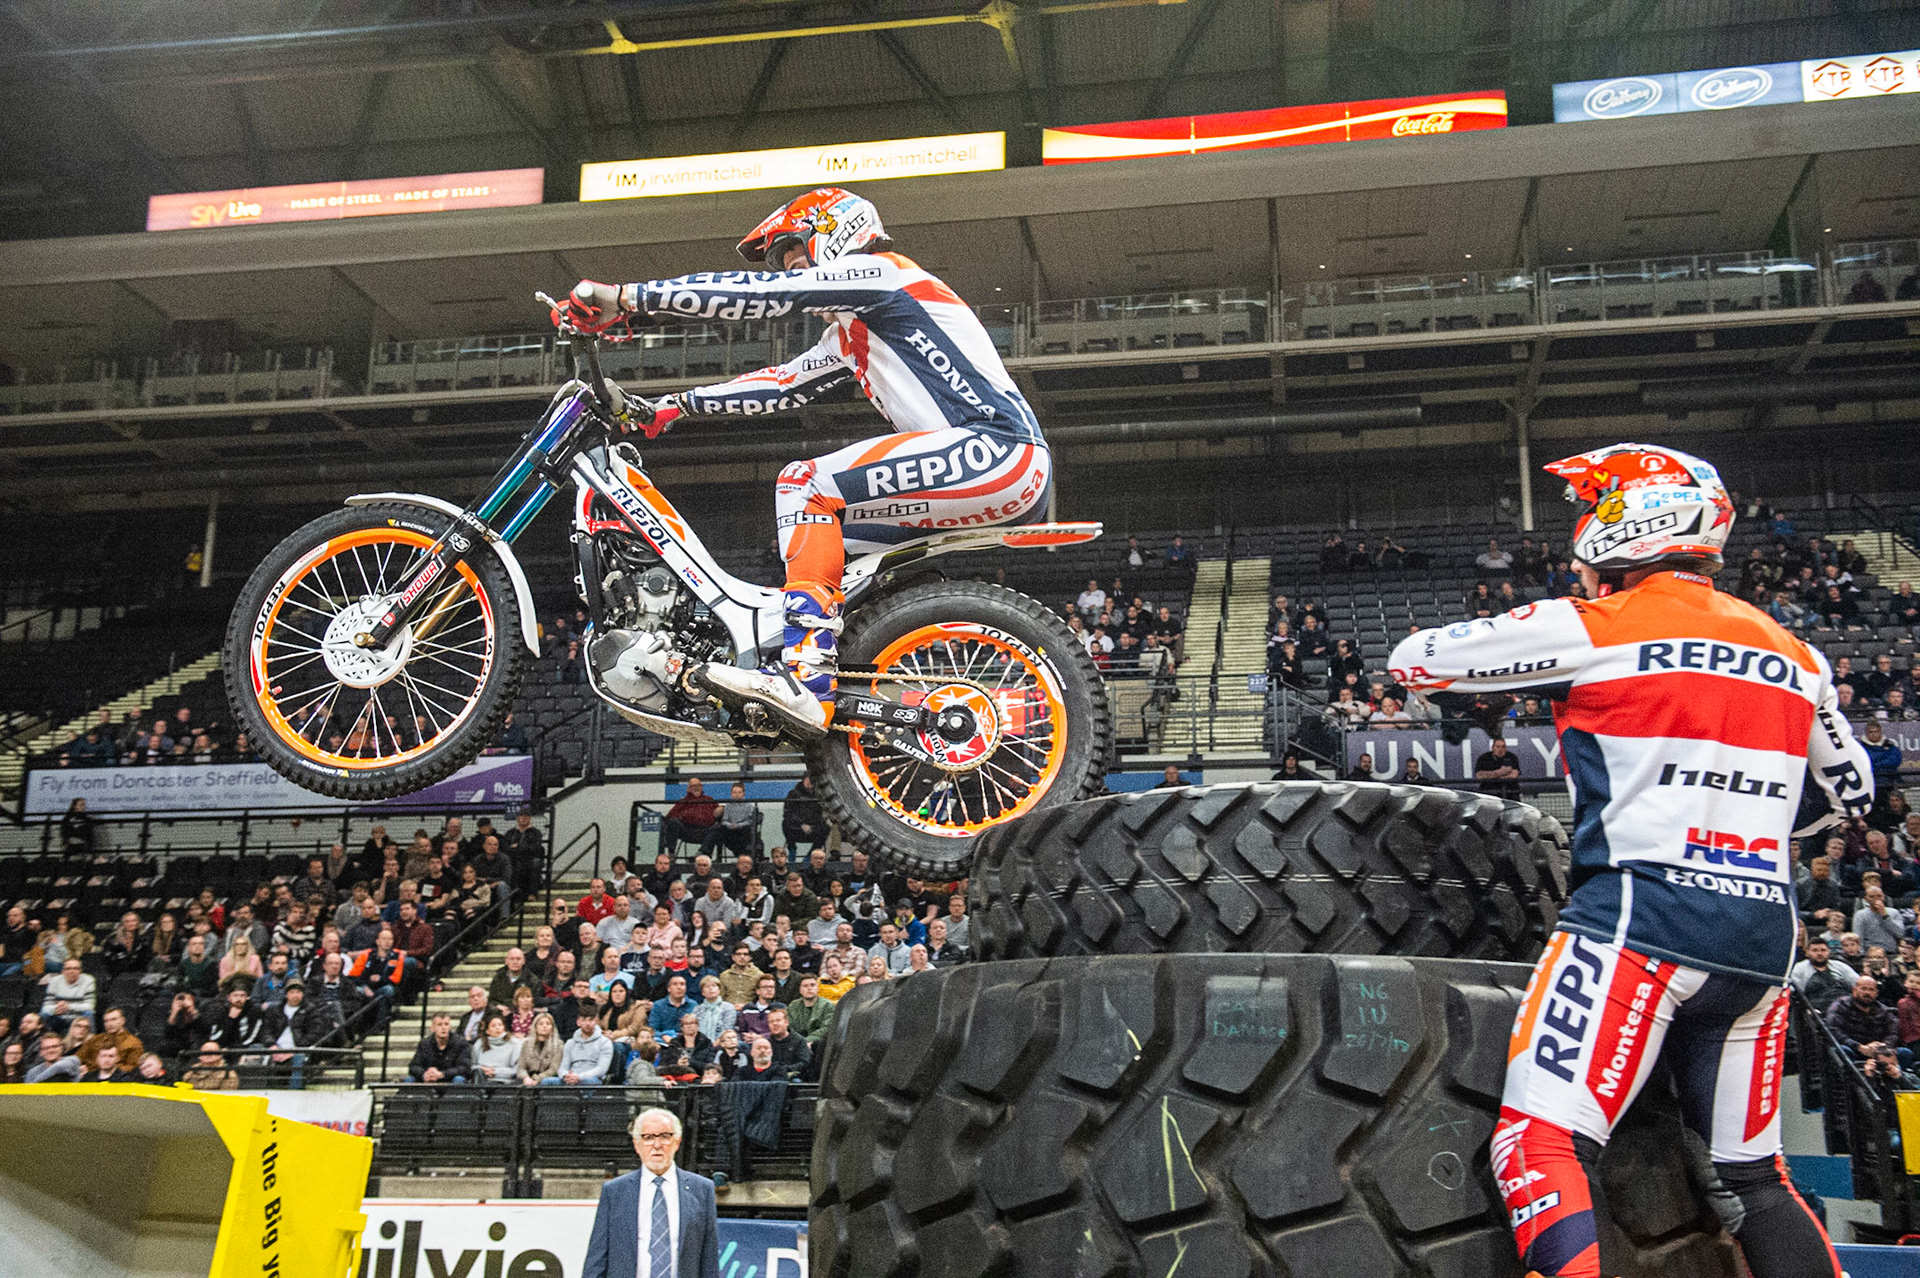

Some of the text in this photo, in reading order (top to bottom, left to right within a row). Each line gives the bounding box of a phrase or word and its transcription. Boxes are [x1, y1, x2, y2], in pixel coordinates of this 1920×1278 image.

[229, 202, 262, 218] Live
[346, 194, 381, 206] STEEL
[394, 190, 430, 202] MADE
[451, 186, 489, 197] STARS
[816, 268, 881, 281] hebo
[904, 328, 996, 422] HONDA
[866, 433, 1008, 498] REPSOL
[611, 487, 673, 551] REPSOL
[853, 501, 930, 520] hebo
[899, 468, 1045, 528] Montesa
[1584, 512, 1677, 563] hebo
[402, 561, 438, 605] SHOWA
[254, 581, 286, 642] REPSOL
[979, 626, 1041, 667] REPSOL
[1467, 658, 1558, 679] hebo
[1638, 641, 1803, 691] REPSOL
[857, 701, 883, 713] NGK
[40, 775, 62, 793] Fly
[68, 775, 107, 791] from
[113, 773, 199, 790] Doncaster
[1683, 827, 1779, 872] HRC
[1664, 868, 1787, 905] HONDA
[1597, 982, 1653, 1098] Montesa
[1760, 1004, 1788, 1116] Mntesa
[262, 1142, 279, 1191] the
[261, 1196, 282, 1250] Big
